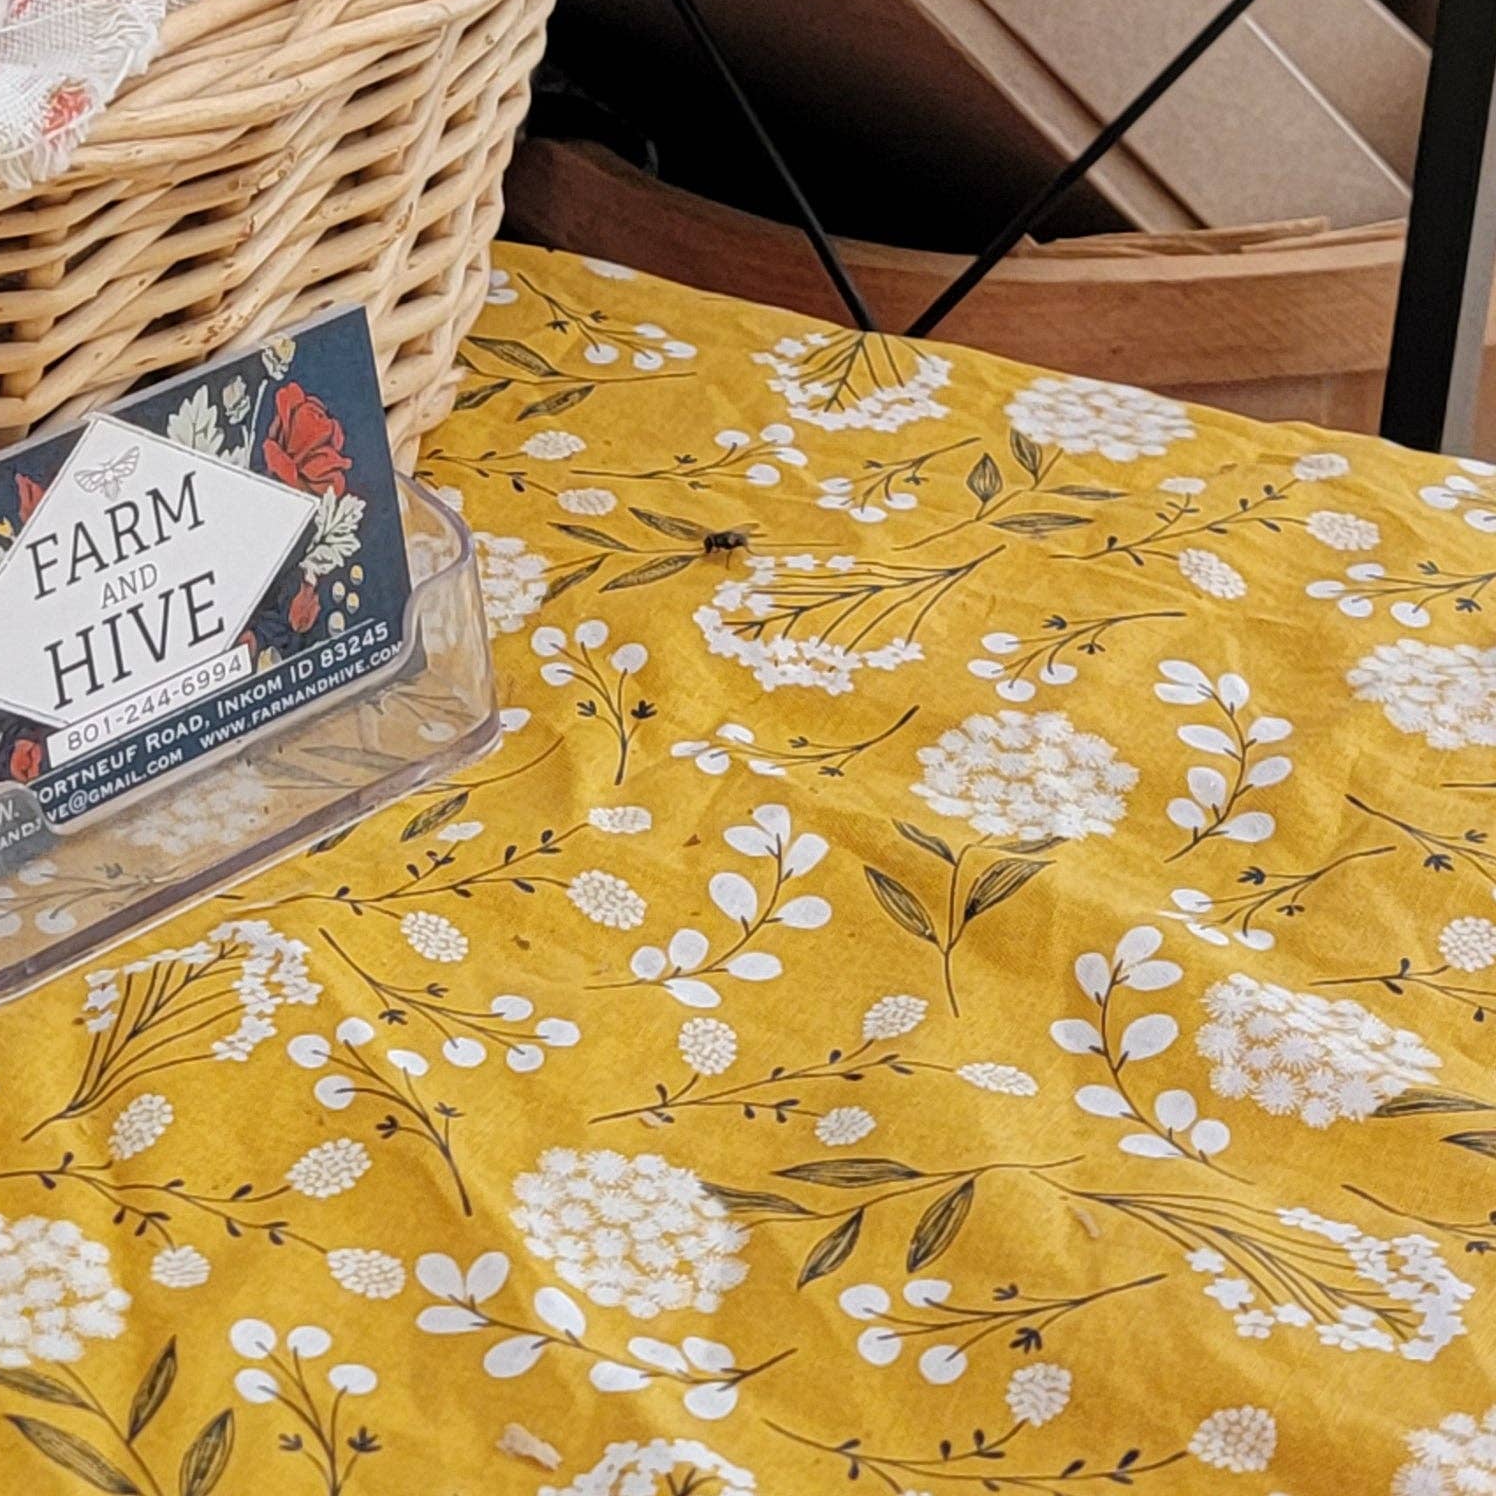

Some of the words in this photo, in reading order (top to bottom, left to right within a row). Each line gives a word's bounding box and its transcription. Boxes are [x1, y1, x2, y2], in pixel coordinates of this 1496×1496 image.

[25, 470, 205, 600] FARM
[101, 563, 157, 609] AND
[44, 571, 224, 710] HIVE
[145, 714, 210, 754] ROAD,
[217, 675, 283, 719] INKOM
[289, 660, 314, 685] ID
[320, 622, 389, 669] 83245
[199, 641, 404, 750] WWW.FARMANDHIVE.COM
[67, 654, 242, 752] 801-244-6994
